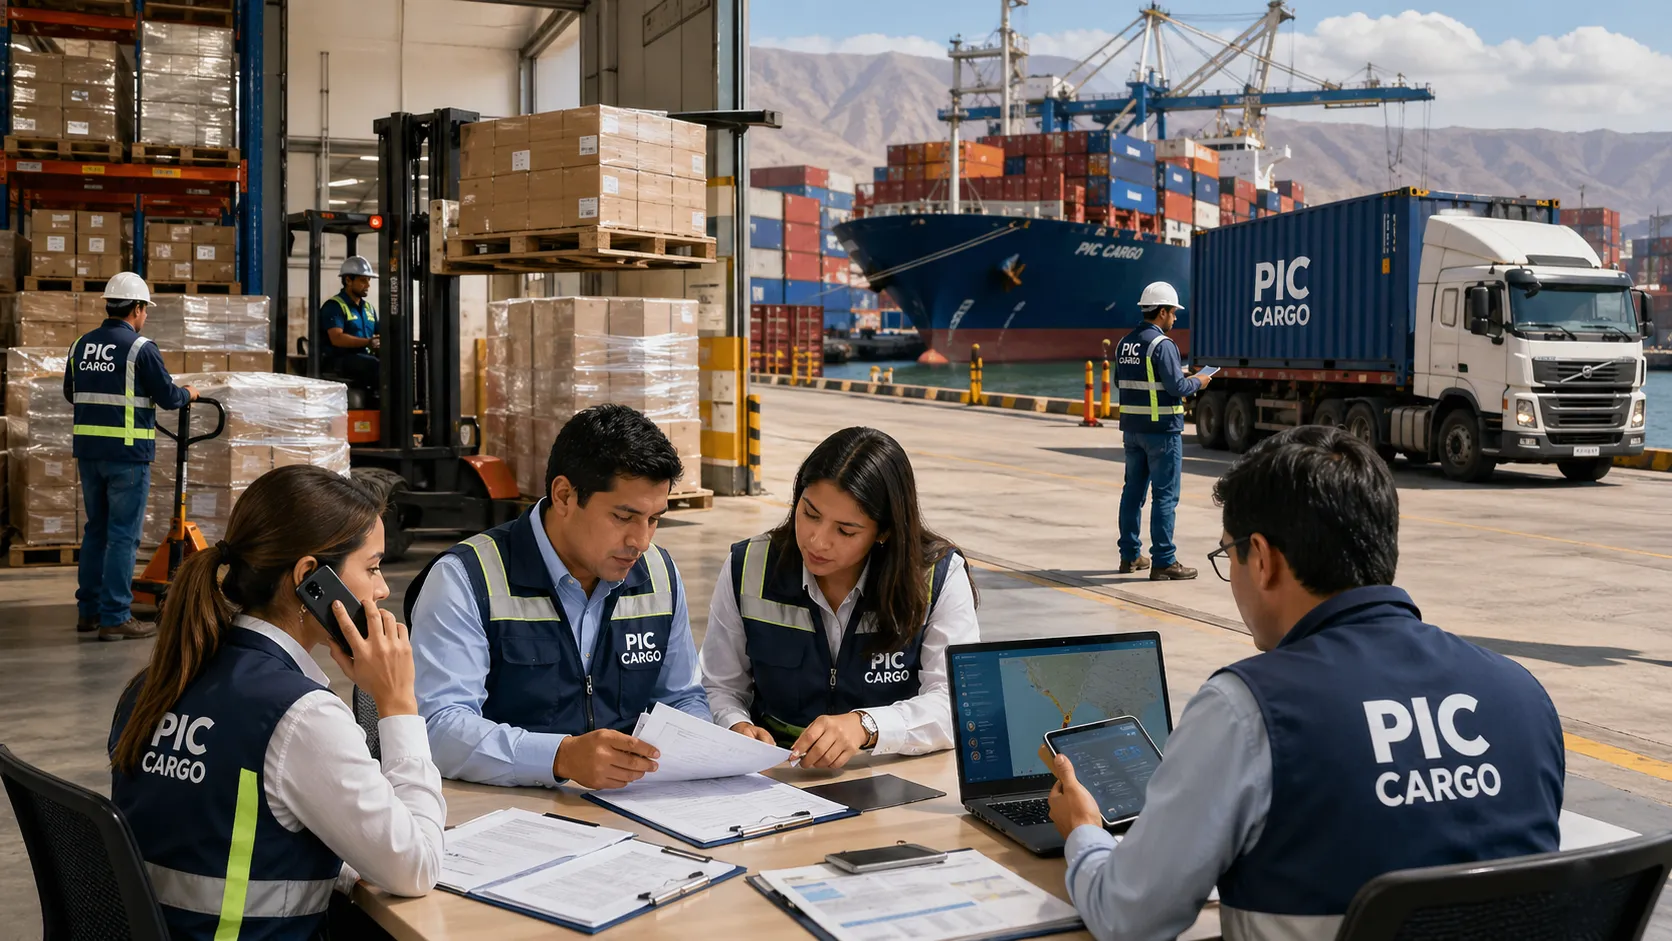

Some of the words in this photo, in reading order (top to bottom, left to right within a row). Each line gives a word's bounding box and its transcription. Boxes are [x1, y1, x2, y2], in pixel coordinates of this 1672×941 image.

[1075, 242, 1103, 256] PIC
[1102, 244, 1144, 260] CARGO
[1254, 255, 1311, 302] PIC
[1251, 303, 1311, 328] CARGO
[82, 342, 117, 362] PIC
[1121, 342, 1141, 356] PIC
[79, 361, 116, 373] CARGO
[625, 631, 656, 651] PIC
[621, 650, 662, 665] CARGO
[871, 651, 906, 670] PIC
[864, 670, 910, 684] CARGO
[151, 712, 215, 756] PIC
[1362, 693, 1491, 764] PIC
[142, 751, 206, 784] CARGO
[1375, 762, 1502, 807] CARGO
